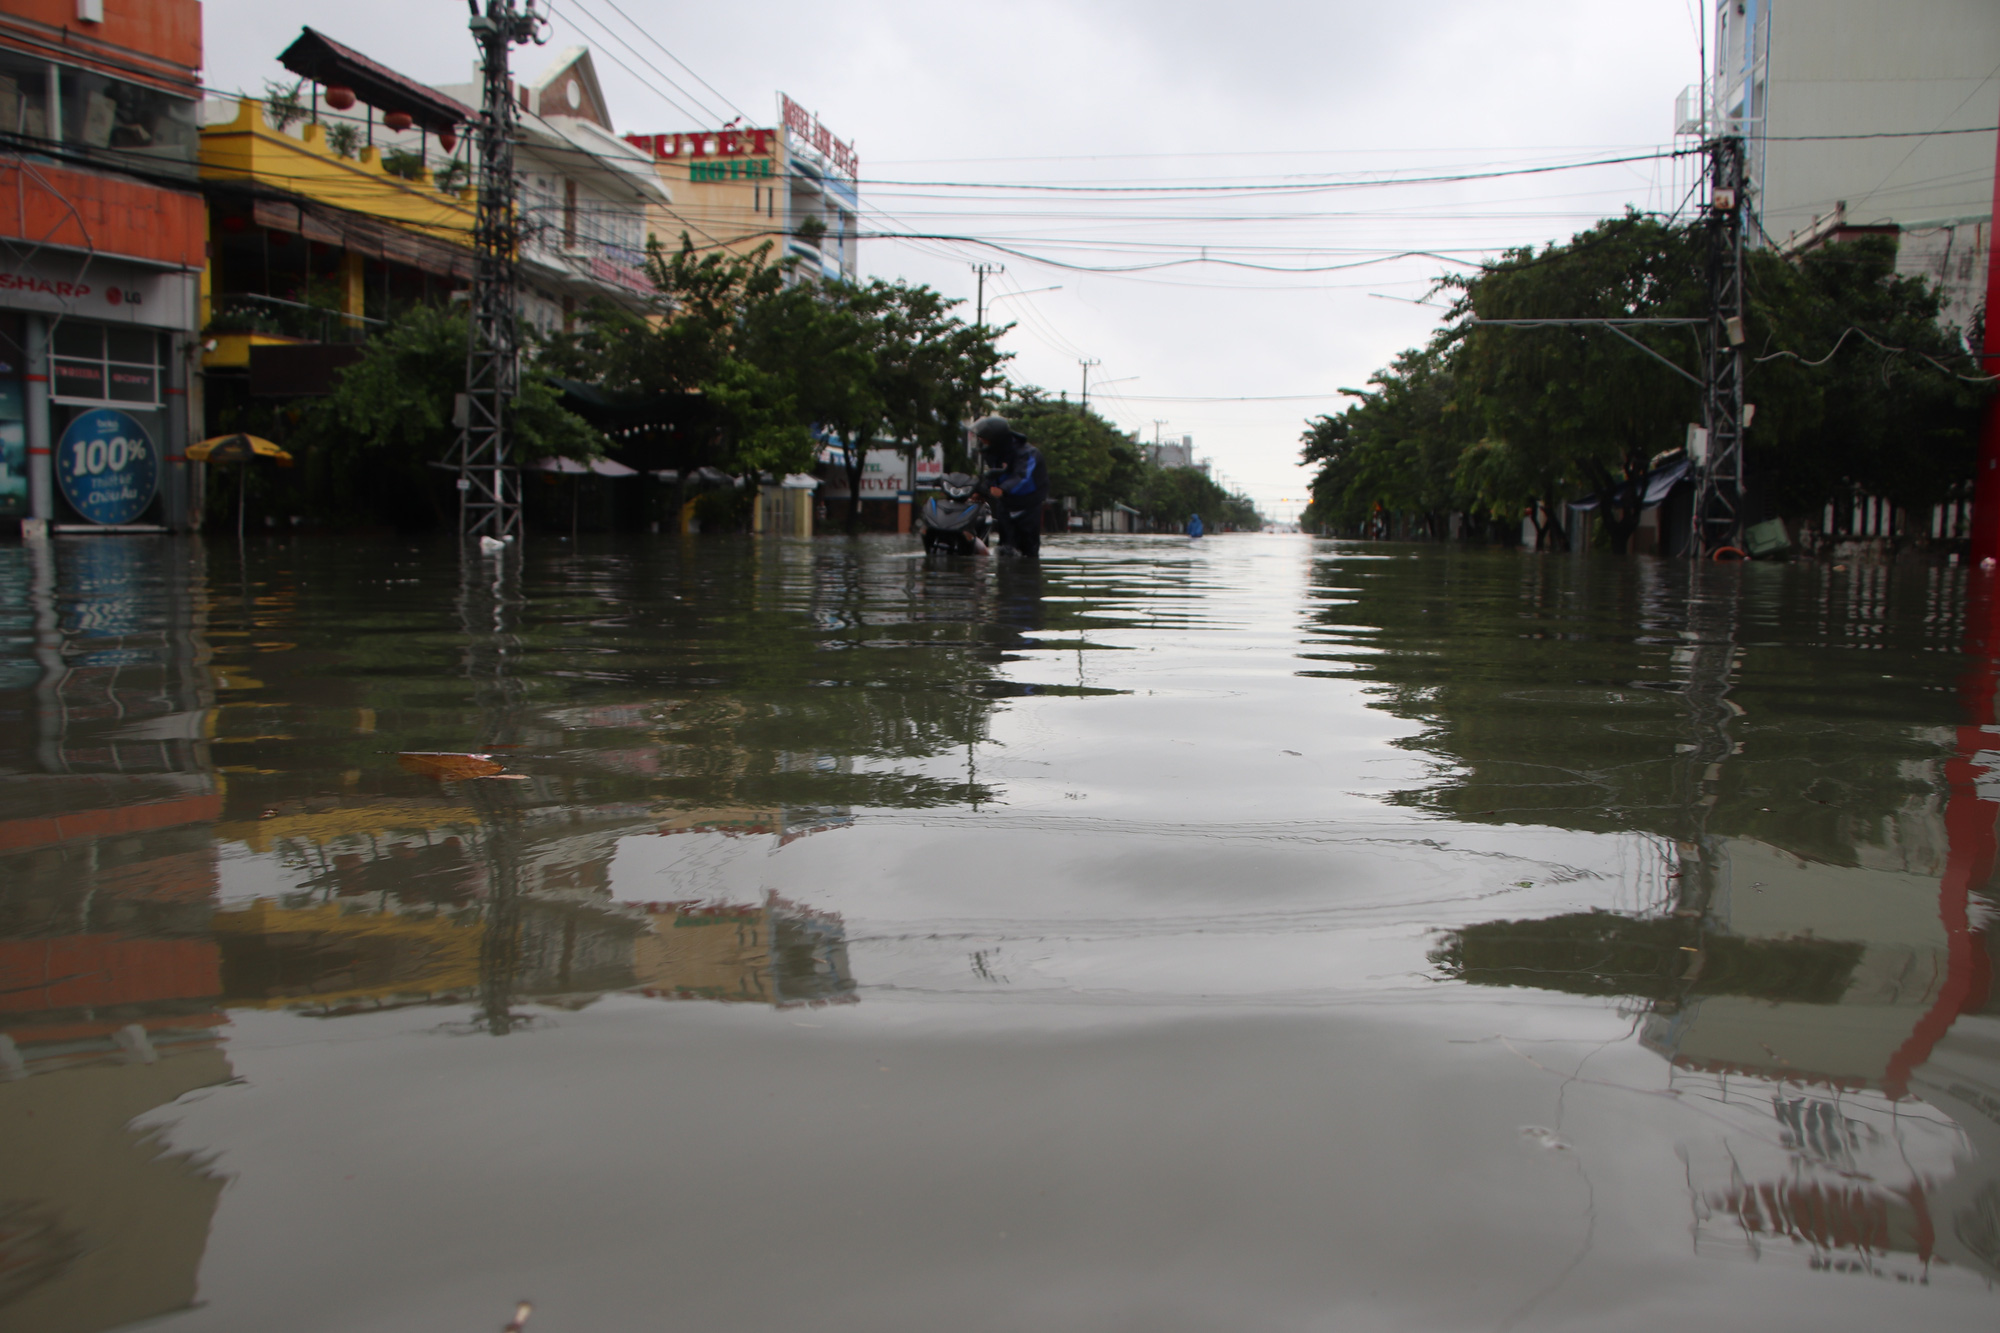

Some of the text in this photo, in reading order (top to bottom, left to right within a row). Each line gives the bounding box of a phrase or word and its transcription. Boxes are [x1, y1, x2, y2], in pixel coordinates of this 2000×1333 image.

[689, 158, 775, 183] HOTEL
[0, 273, 91, 298] SHARP
[125, 290, 142, 304] LG
[55, 365, 101, 379] TOSHIBA
[112, 373, 151, 384] SONY
[72, 436, 147, 476] 100%
[860, 473, 903, 490] TUYẾT
